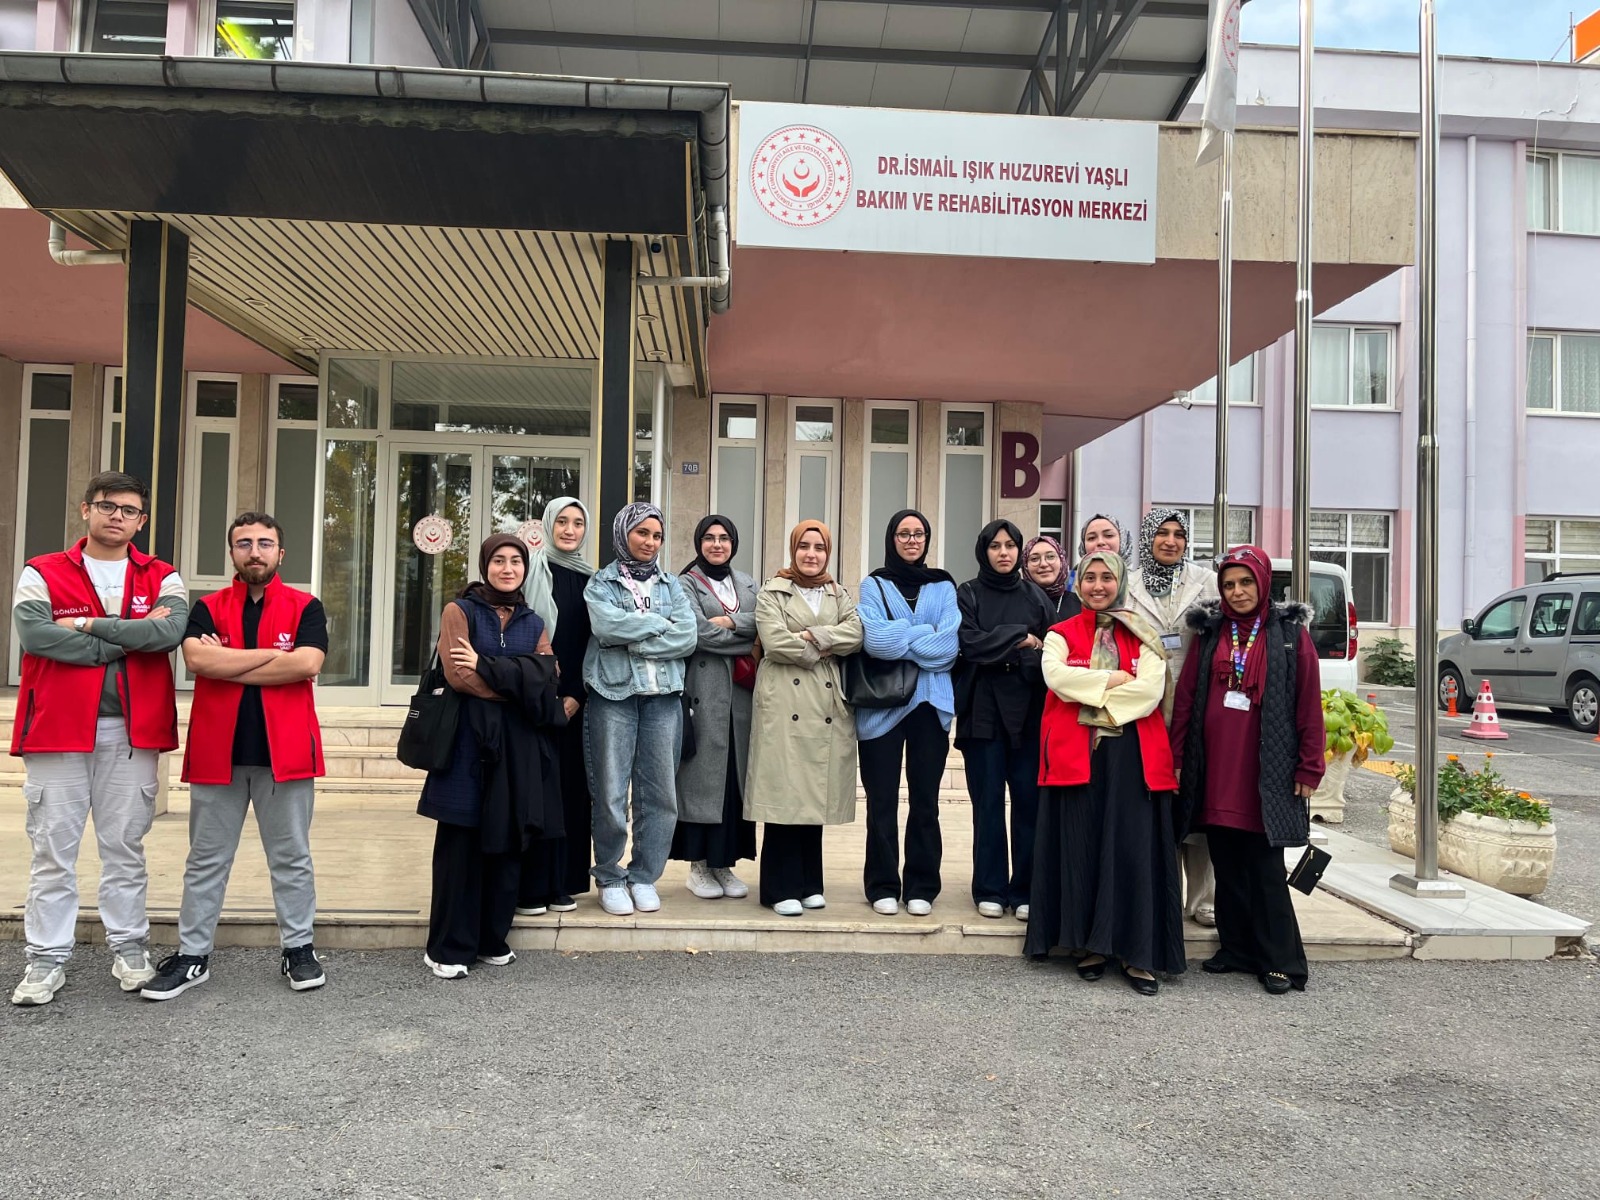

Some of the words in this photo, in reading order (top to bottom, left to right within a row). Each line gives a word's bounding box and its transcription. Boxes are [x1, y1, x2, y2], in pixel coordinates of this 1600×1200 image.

[803, 145, 823, 157] SOSYAL
[878, 153, 958, 178] DR.İSMAİL
[963, 160, 995, 184] IŞIK
[1000, 162, 1079, 184] HUZUREVİ
[1085, 166, 1128, 190] YAŞLI
[856, 189, 908, 210] BAKIM
[912, 192, 933, 211] VE
[938, 192, 1073, 218] REHABİLİTASYON
[1078, 199, 1147, 221] MERKEZİ
[1001, 431, 1041, 499] B
